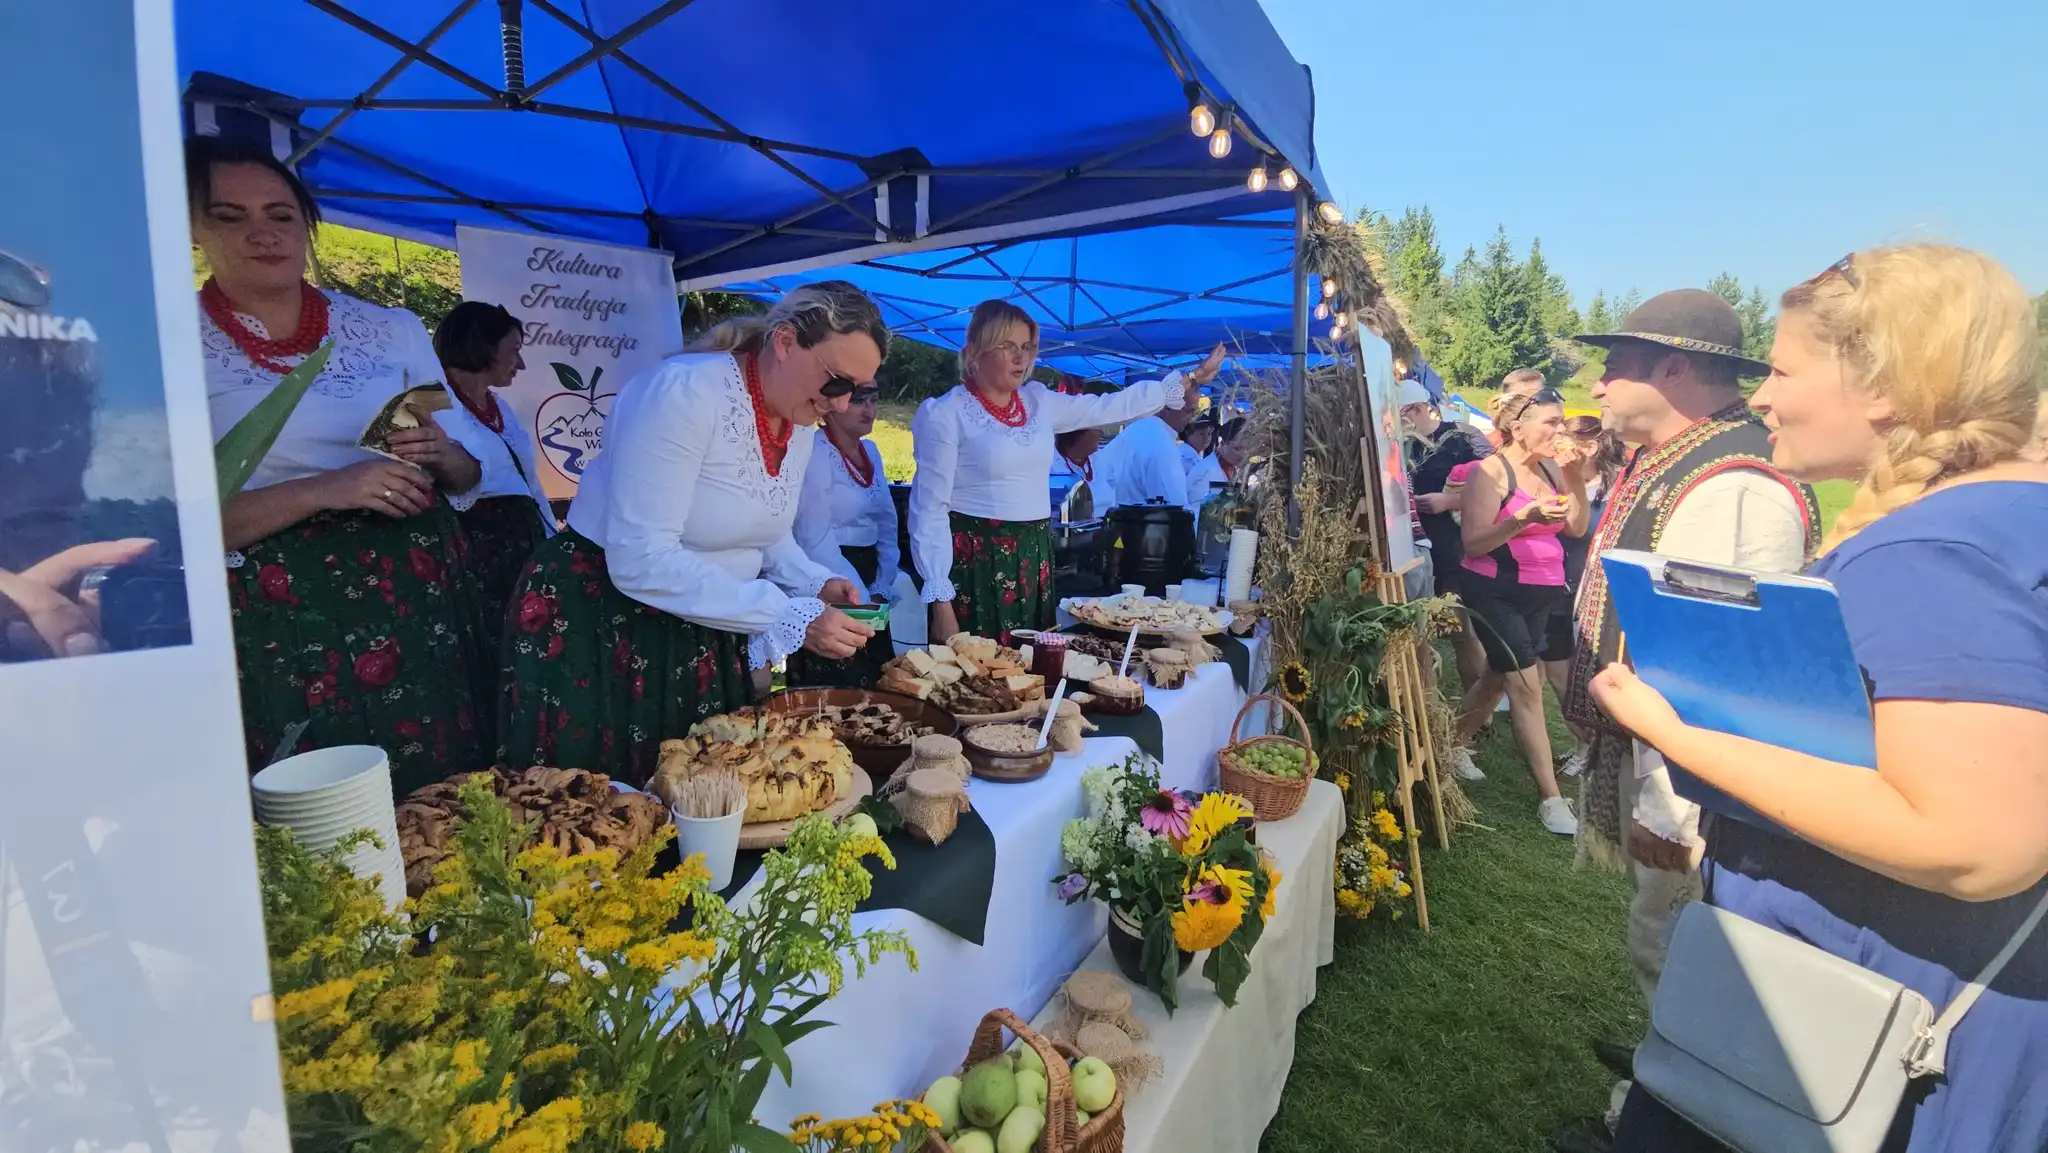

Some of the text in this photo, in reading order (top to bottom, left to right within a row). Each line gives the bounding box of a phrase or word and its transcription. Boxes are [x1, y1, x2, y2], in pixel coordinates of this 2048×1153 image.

[526, 246, 623, 279] Kultura
[520, 283, 627, 321] Tradycja
[522, 321, 639, 358] Integracja
